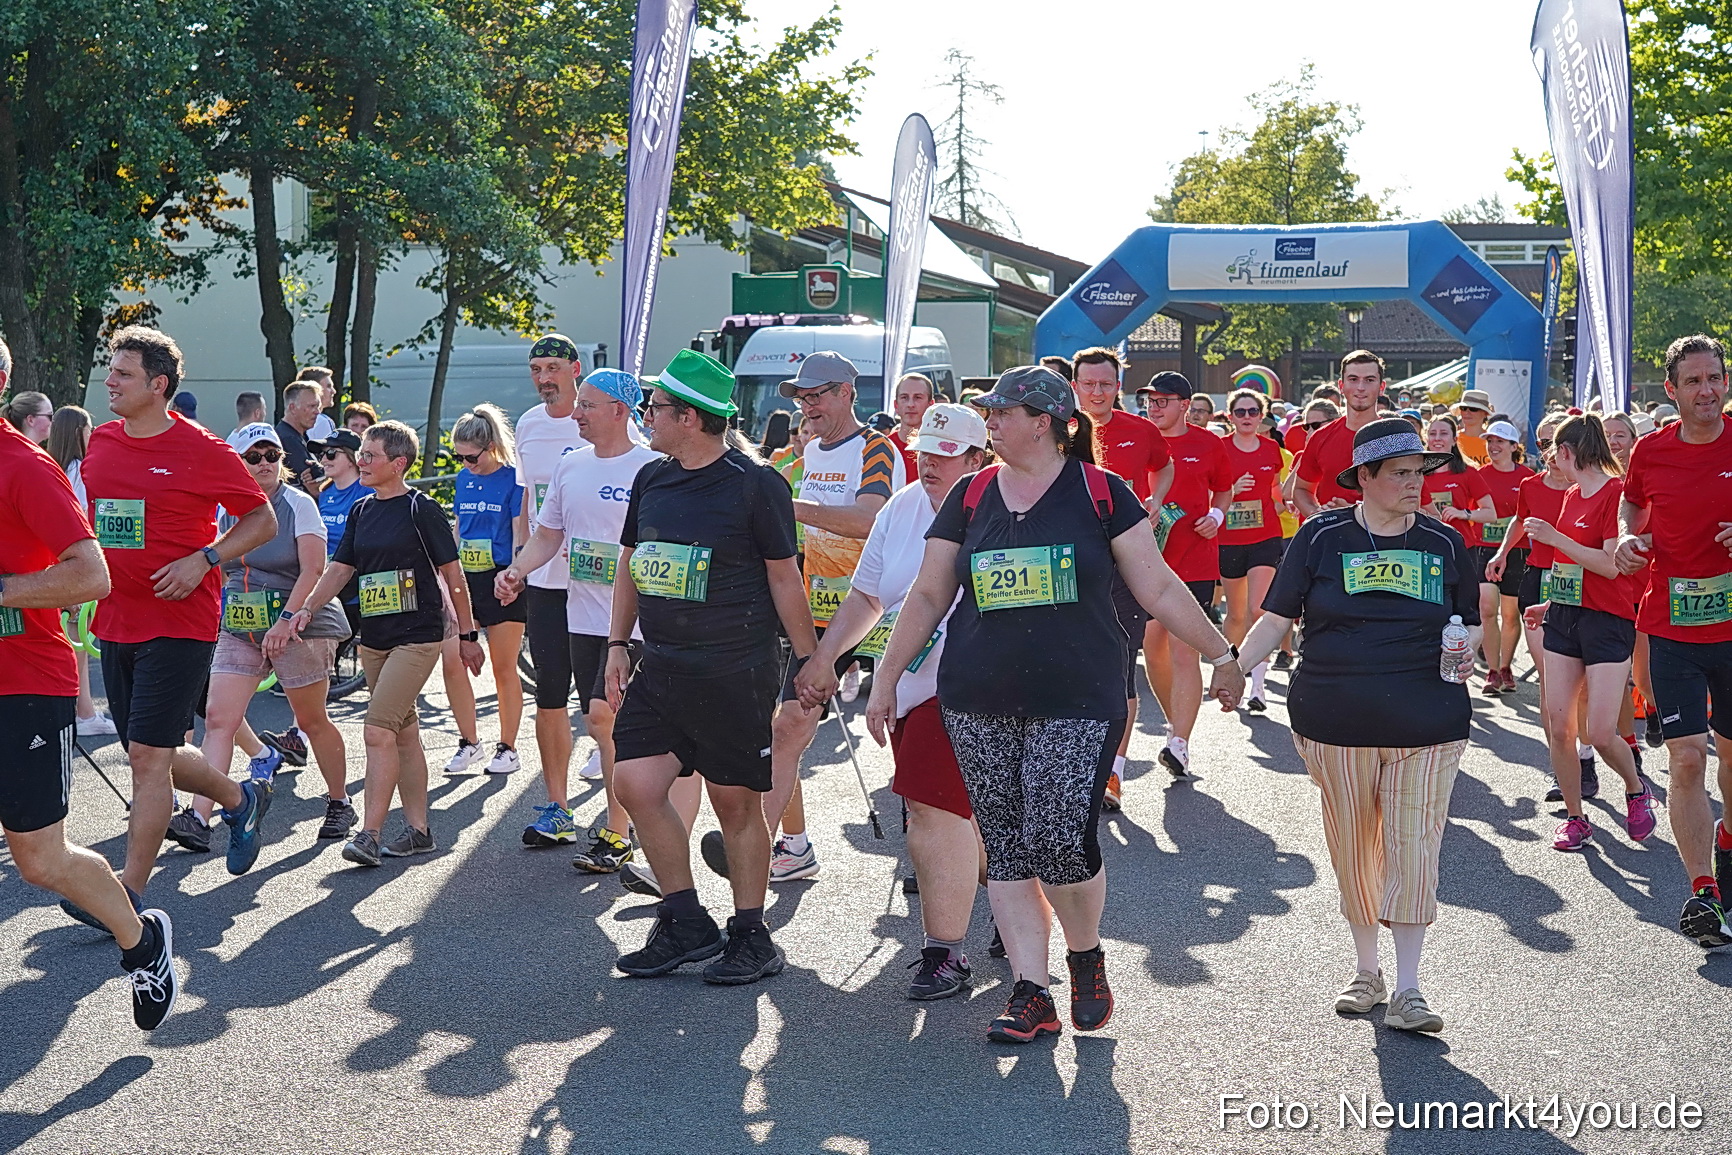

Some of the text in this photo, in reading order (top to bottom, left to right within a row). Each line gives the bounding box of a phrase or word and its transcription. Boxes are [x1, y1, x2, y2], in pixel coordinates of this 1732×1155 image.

[1283, 245, 1314, 254] Fischer
[1260, 259, 1350, 279] firmenlauf
[1088, 289, 1138, 301] Fischer
[746, 353, 787, 363] abavent
[249, 430, 266, 438] NIKE
[809, 472, 847, 482] KLEBL
[805, 482, 846, 493] DYNAMICS
[1232, 510, 1257, 521] 1731
[101, 516, 134, 533] 1690
[134, 519, 142, 542] 2022
[463, 550, 482, 562] 737
[578, 553, 604, 571] 946
[607, 560, 615, 581] 2022
[640, 559, 671, 579] 302
[1363, 563, 1404, 579] 270
[648, 578, 676, 588] Sebastian
[675, 566, 685, 591] 2022
[990, 567, 1029, 590] 291
[1040, 568, 1049, 596] 2022
[1348, 569, 1356, 589] WALK
[1395, 578, 1410, 588] Inge
[1411, 568, 1419, 592] 2022
[1551, 574, 1575, 592] 1704
[365, 586, 387, 603] 274
[391, 587, 399, 608] 2022
[976, 575, 985, 604] WALK
[986, 588, 1039, 600] Pfeiffer Esther
[816, 591, 841, 607] 544
[1680, 591, 1727, 611] 1723
[232, 606, 255, 619] 278
[259, 607, 267, 626] 2022
[1703, 608, 1727, 617] Norbert
[28, 740, 48, 750] adidas
